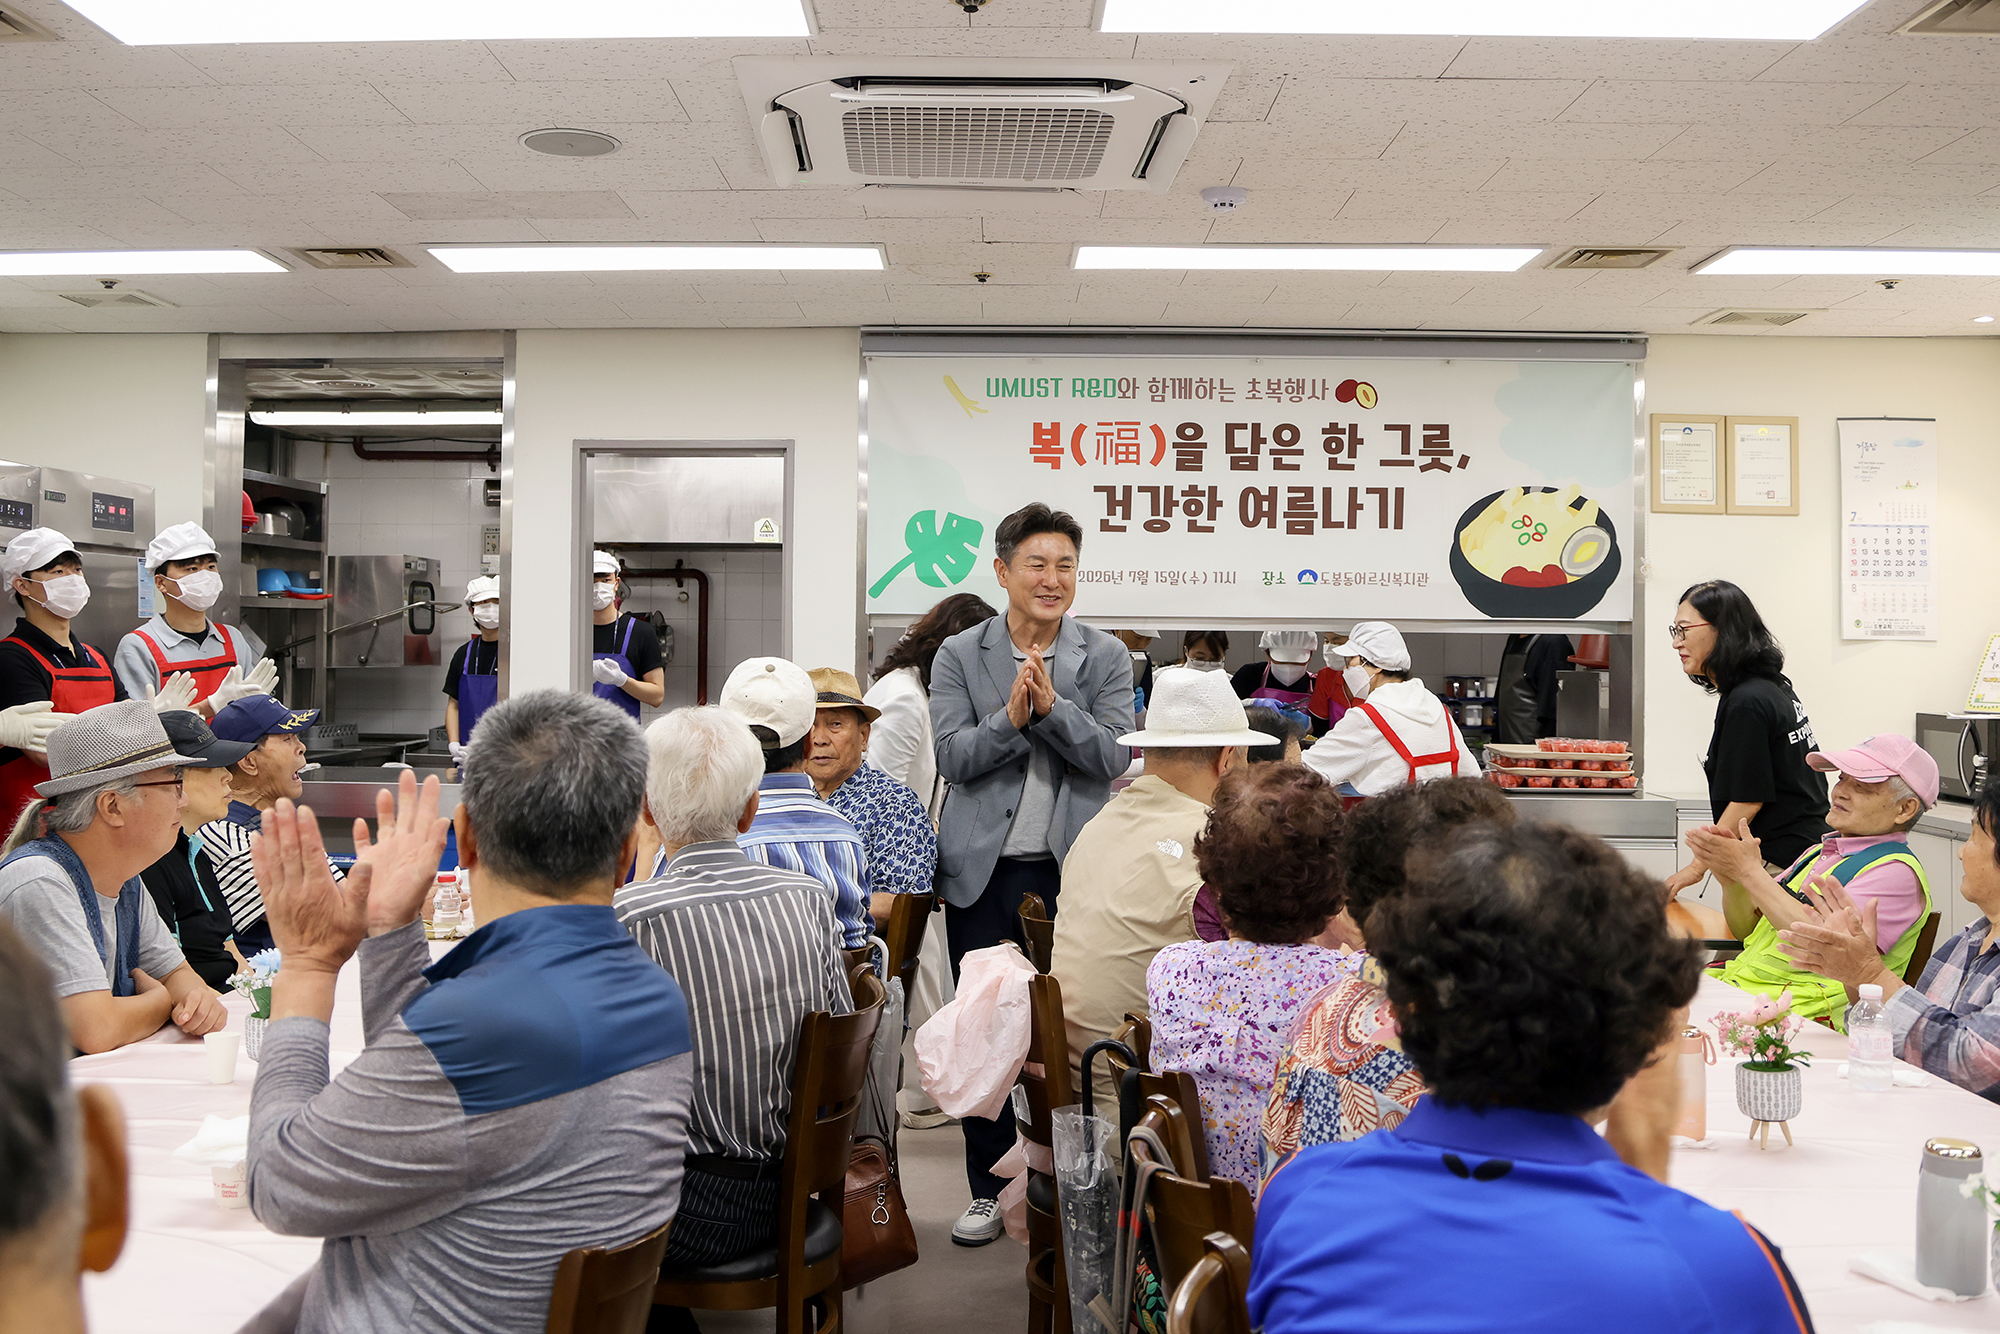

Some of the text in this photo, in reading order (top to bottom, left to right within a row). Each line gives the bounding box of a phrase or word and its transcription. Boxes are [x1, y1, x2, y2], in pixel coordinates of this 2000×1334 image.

[986, 377, 1330, 403] UMUST R&D와 함께하는 초복행사
[1029, 421, 1471, 473] 복(福)을 담은 한 그릇,
[1093, 484, 1405, 536] 건강한 여름나기
[1850, 511, 1857, 521] 7
[1078, 570, 1430, 587] 2026년 7월 15일(수) 11시 장소 도봉동어르신복지관
[1852, 584, 1856, 592] 8
